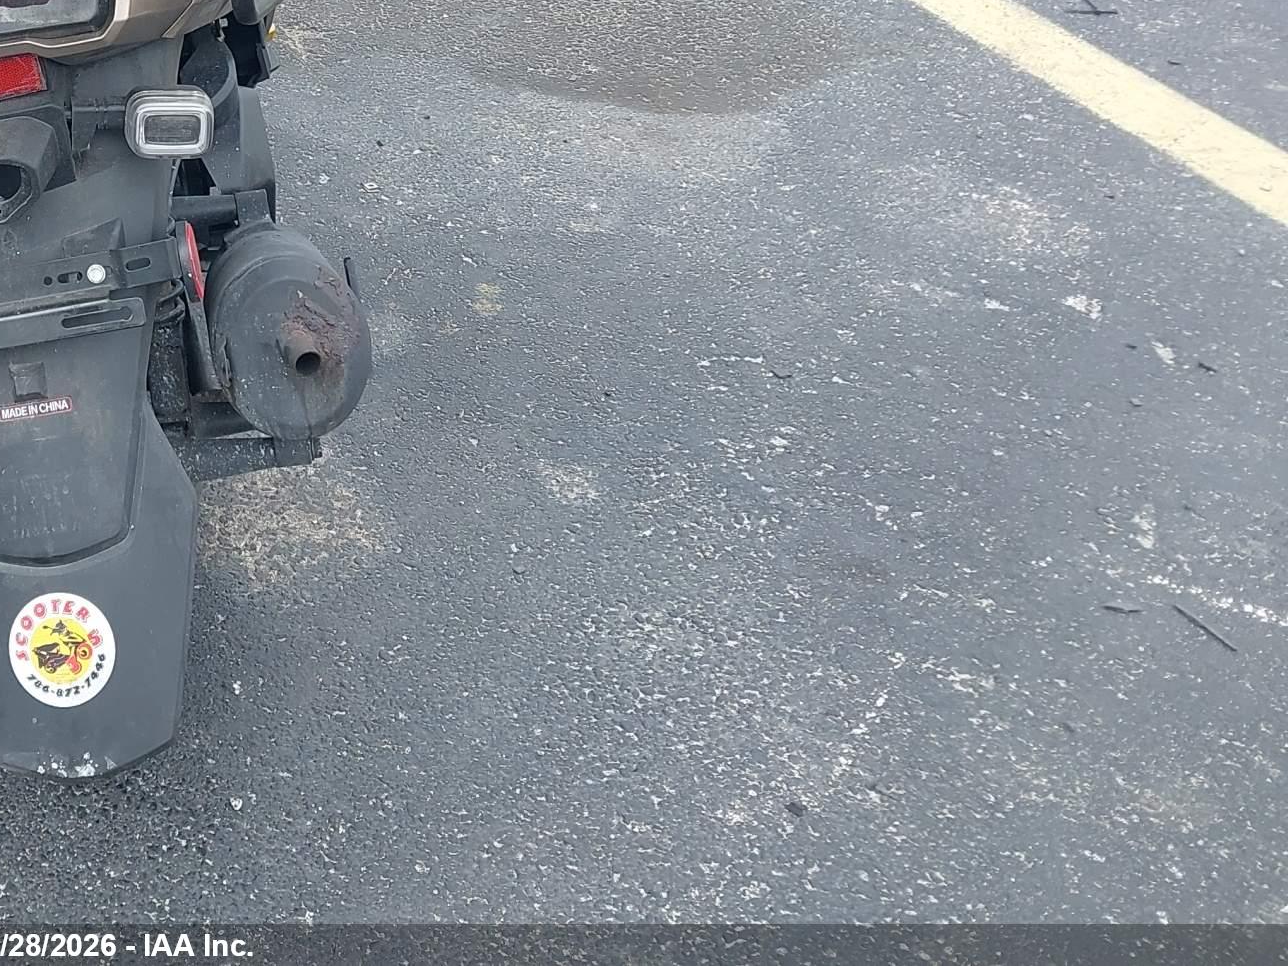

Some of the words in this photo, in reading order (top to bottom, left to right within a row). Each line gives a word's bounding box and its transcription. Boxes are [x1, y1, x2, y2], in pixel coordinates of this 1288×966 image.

[1, 406, 28, 419] MADE
[28, 404, 39, 415] IN
[39, 399, 69, 413] CHINA
